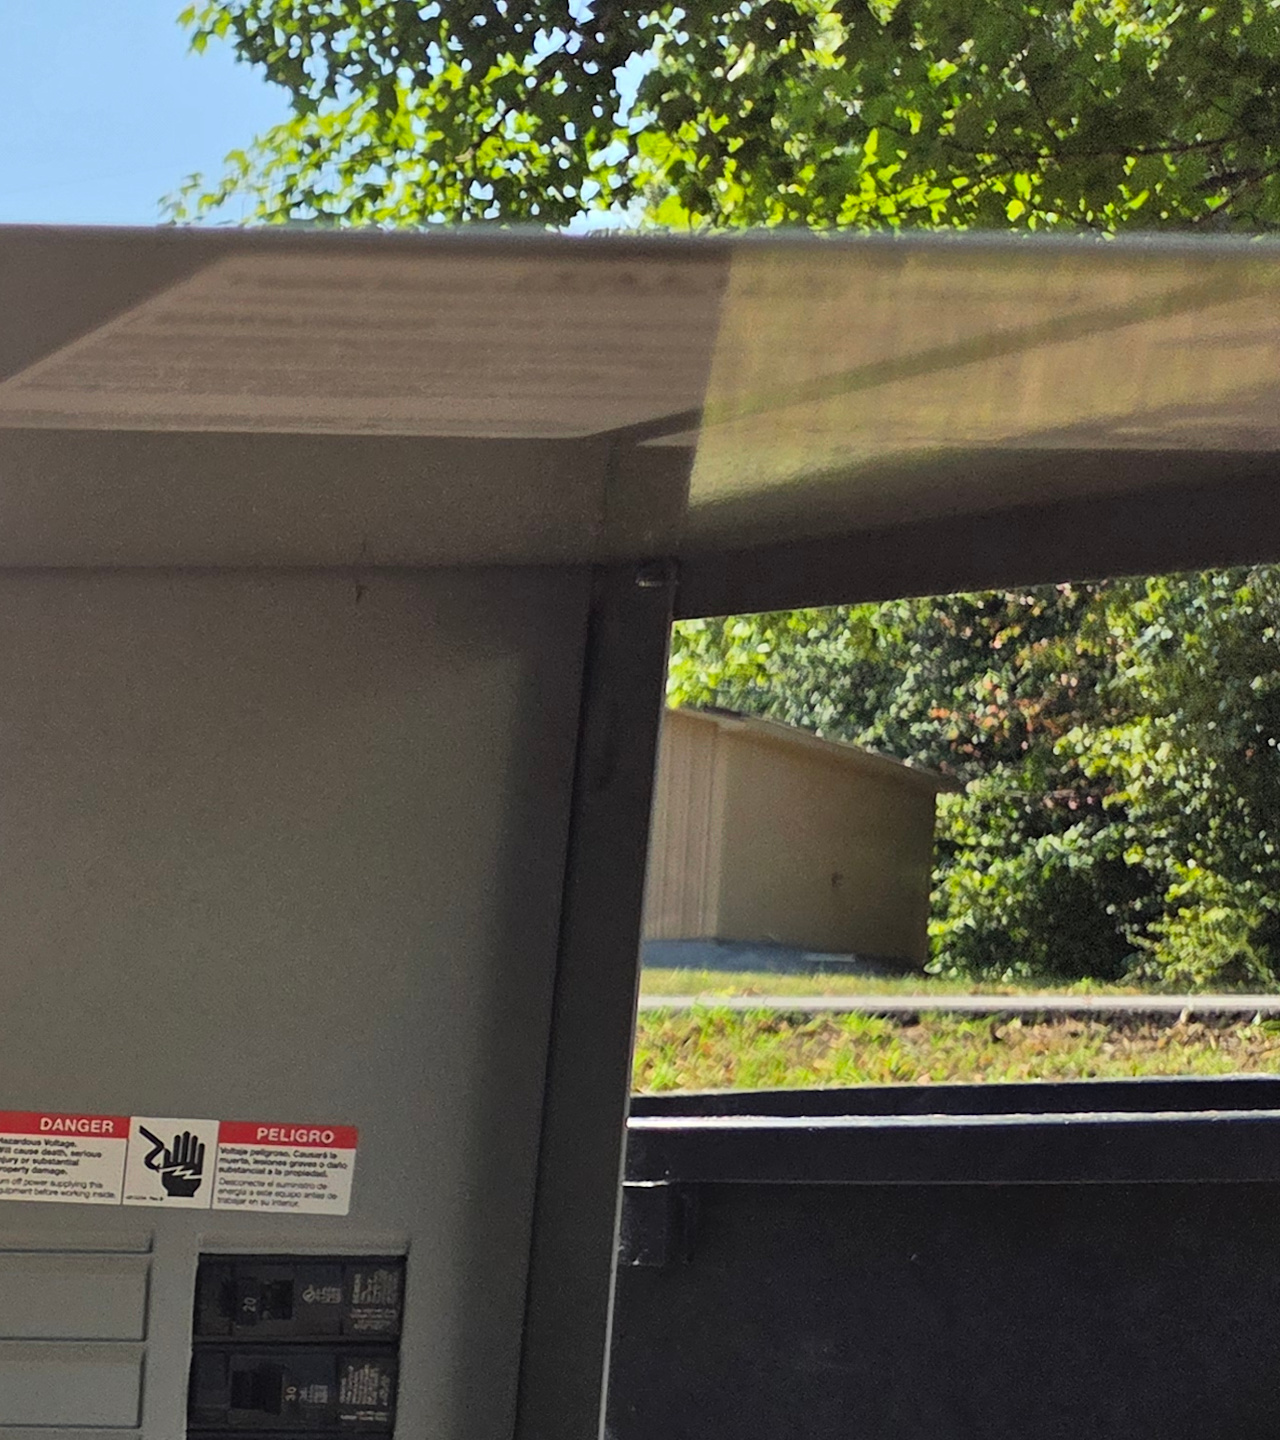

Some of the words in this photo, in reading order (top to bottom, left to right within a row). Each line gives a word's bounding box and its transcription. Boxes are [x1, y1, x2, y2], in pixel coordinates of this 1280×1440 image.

[40, 1117, 114, 1133] DANGER
[257, 1127, 334, 1144] PELIGRO
[44, 1139, 77, 1148] Voltage.
[13, 1147, 39, 1155] cause
[41, 1148, 68, 1157] death,
[71, 1150, 102, 1158] serious
[32, 1158, 79, 1166] substantial
[31, 1167, 68, 1176] damage.
[243, 1296, 257, 1313] 20
[285, 1386, 297, 1402] 30
